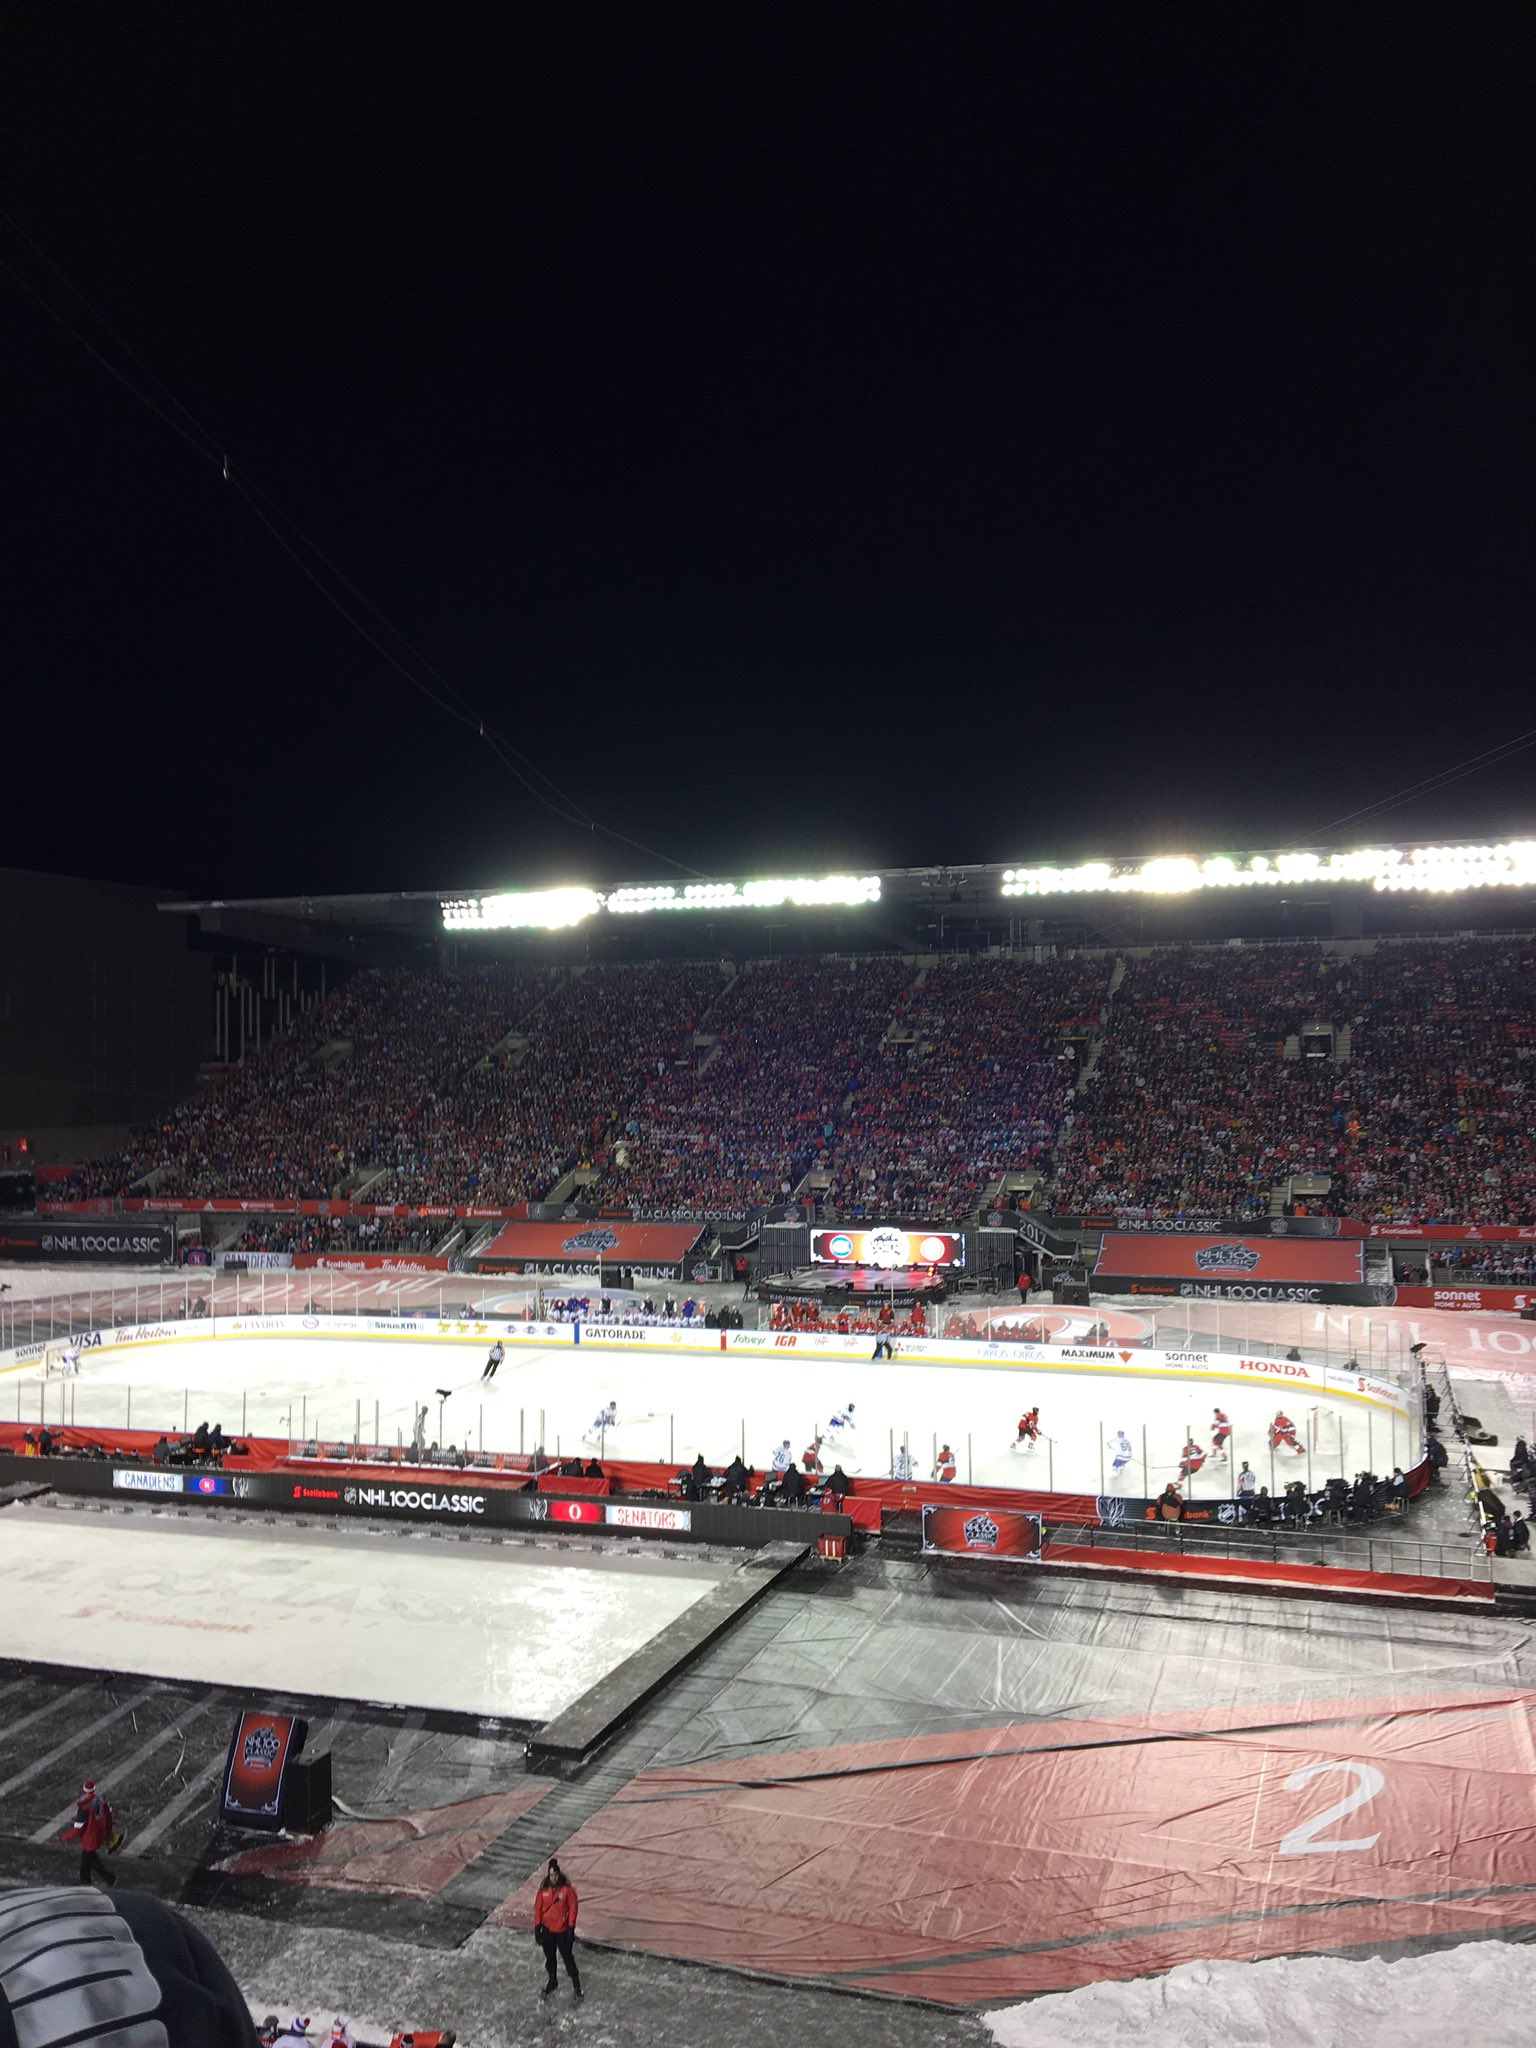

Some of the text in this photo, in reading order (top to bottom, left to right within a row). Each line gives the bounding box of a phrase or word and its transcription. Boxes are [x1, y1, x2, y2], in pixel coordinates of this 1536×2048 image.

[747, 1214, 768, 1239] 1917
[1020, 1219, 1047, 1246] 2017
[1381, 1227, 1424, 1236] Scotiabank
[326, 1259, 366, 1271] Scotiabank
[382, 1259, 427, 1271] Tim Hortons
[1199, 1258, 1255, 1266] CLASSIC
[1433, 1290, 1482, 1301] sonnet
[115, 1323, 178, 1343] Tim Hortons
[585, 1327, 646, 1340] GATORADE
[733, 1333, 767, 1346] Sobeys
[69, 1331, 103, 1349] VISA
[774, 1334, 797, 1347] IGA
[15, 1344, 47, 1358] sonnet
[1165, 1352, 1209, 1363] sonnet
[1239, 1359, 1311, 1378] HONDA
[124, 1471, 175, 1489] CANADIENS
[302, 1488, 339, 1499] Scotiabank
[617, 1507, 676, 1529] SENATORS
[245, 1747, 276, 1758] CLASSIC
[1278, 1760, 1385, 1856] 2
